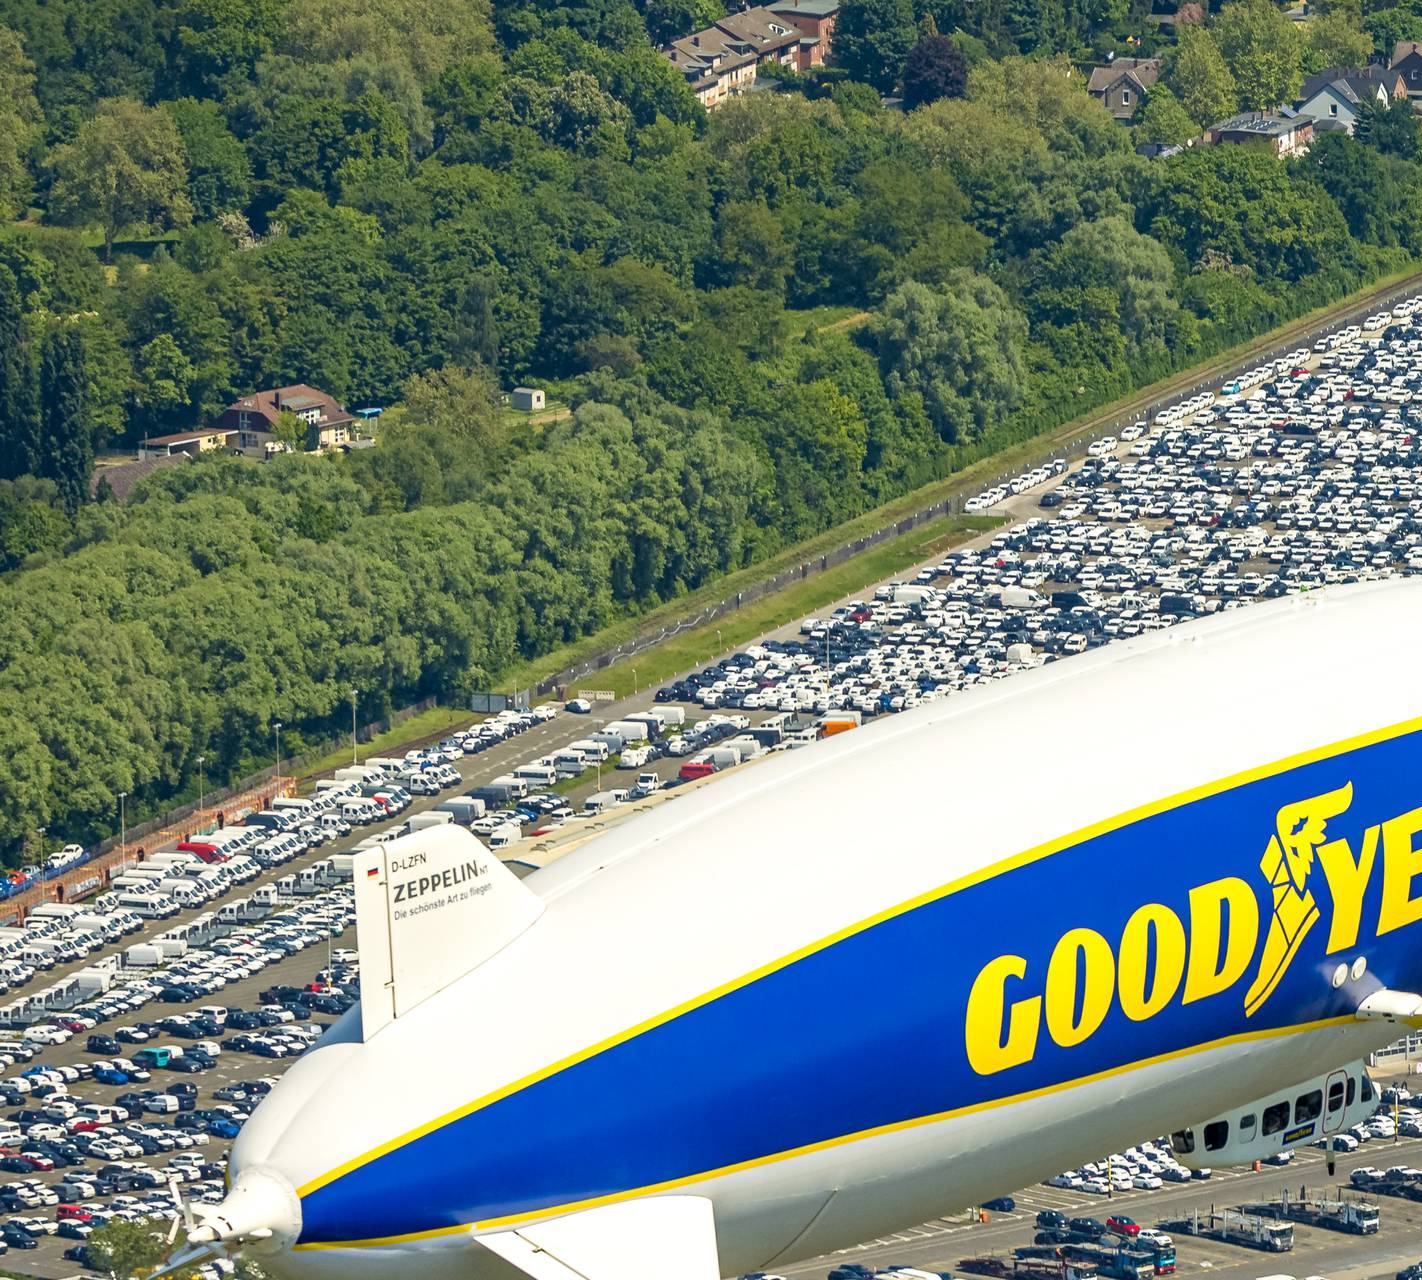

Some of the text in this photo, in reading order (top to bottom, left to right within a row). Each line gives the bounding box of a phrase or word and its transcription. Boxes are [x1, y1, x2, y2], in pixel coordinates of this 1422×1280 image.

[391, 852, 427, 873] D-LZFN
[393, 859, 479, 903] ZEPPELIN
[394, 910, 408, 921] Die
[409, 898, 446, 916] schönste
[447, 893, 459, 905] Art
[460, 892, 469, 901] zu
